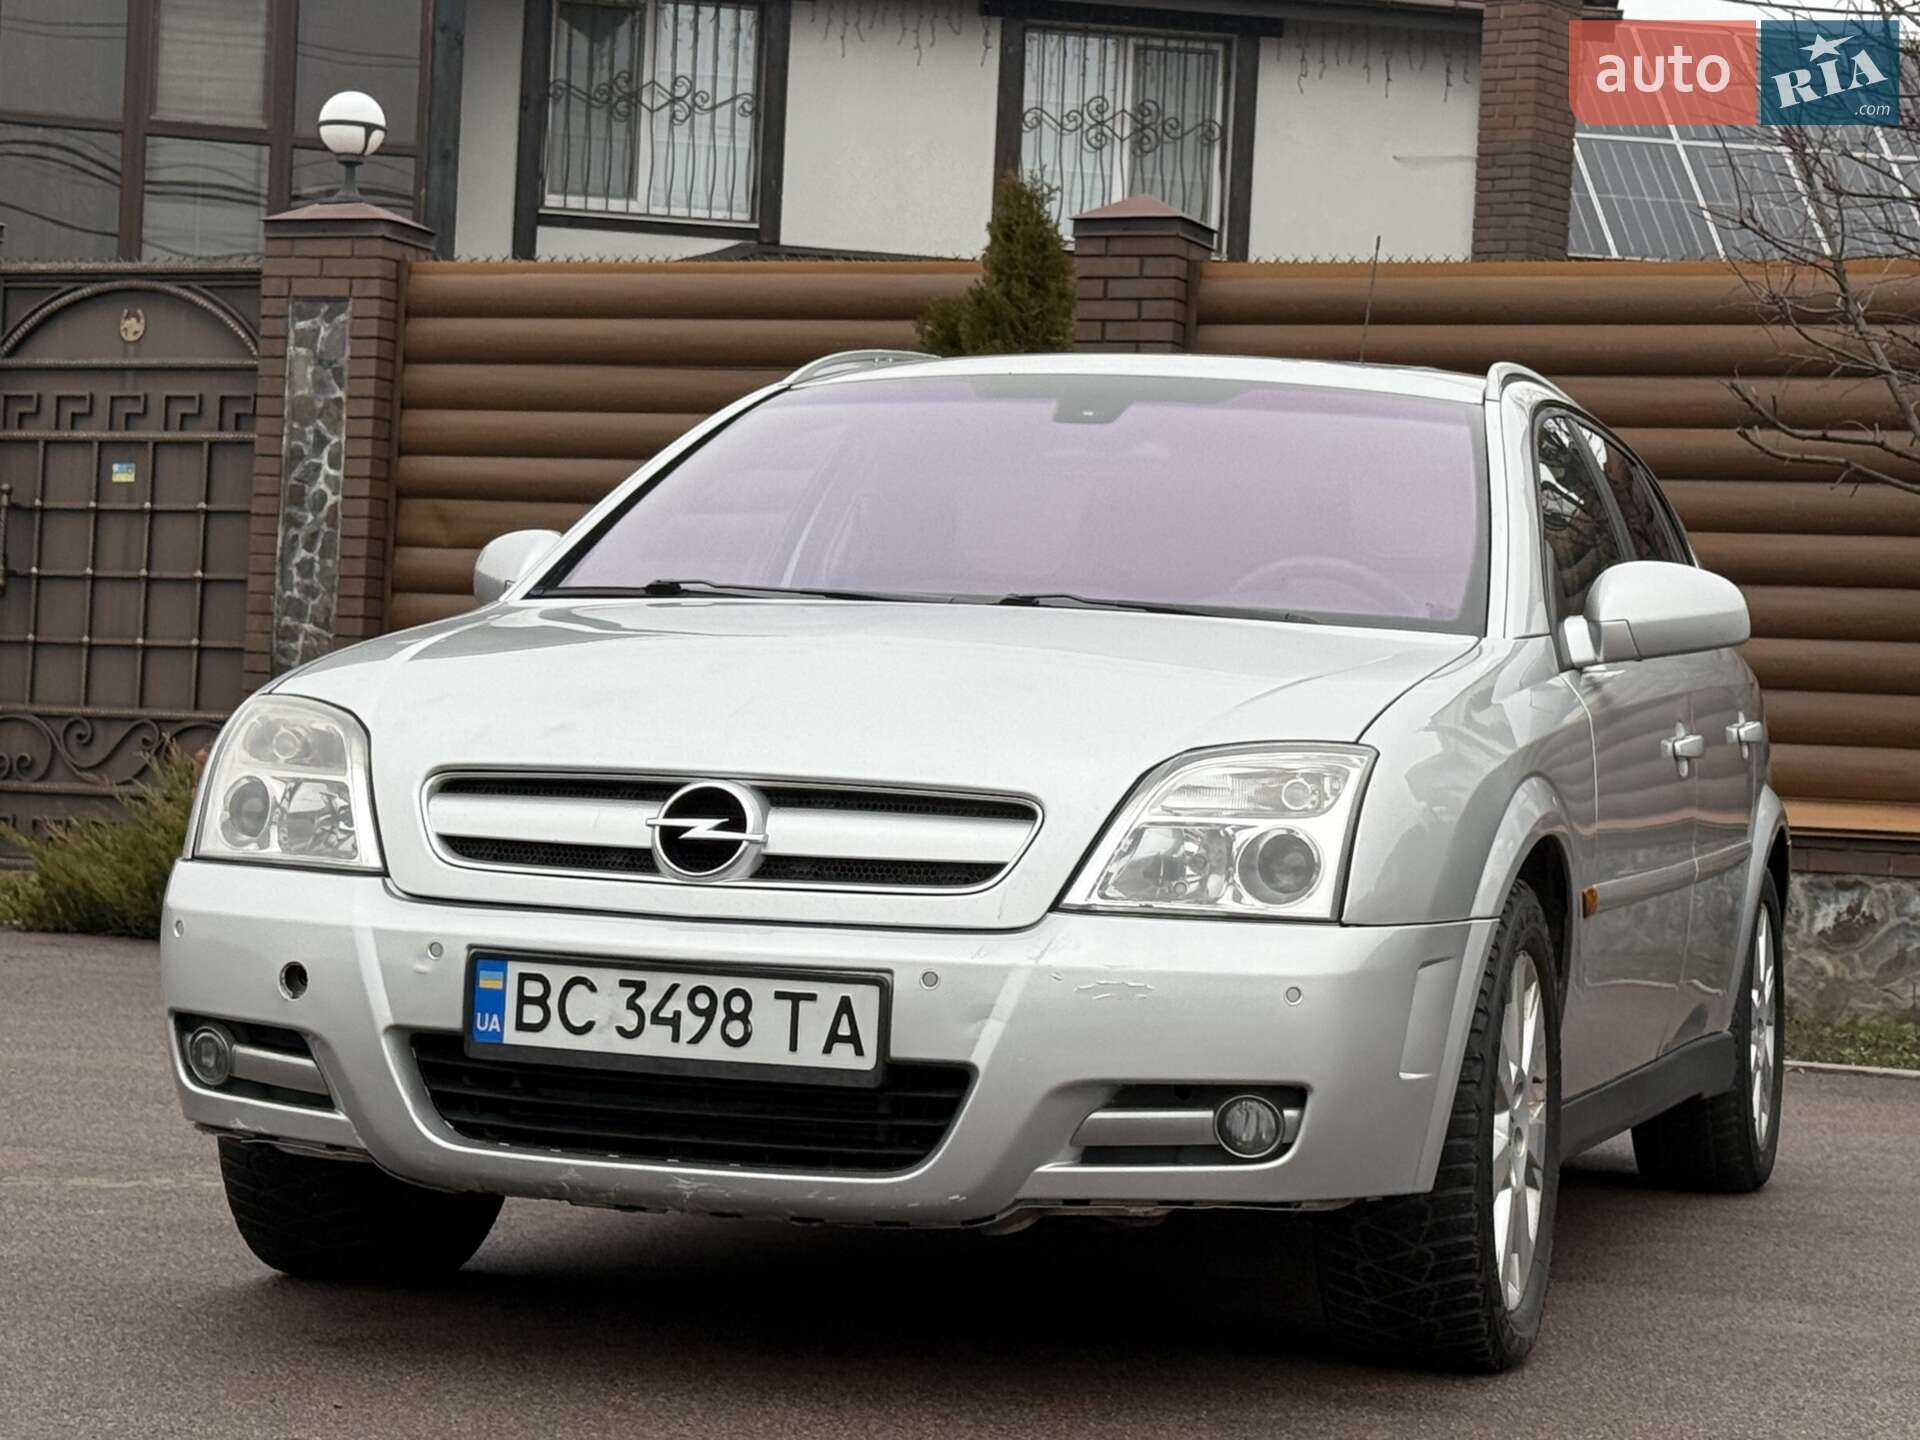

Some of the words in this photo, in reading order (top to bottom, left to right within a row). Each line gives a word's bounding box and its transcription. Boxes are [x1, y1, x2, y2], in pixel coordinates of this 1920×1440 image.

[476, 1012, 501, 1033] UA
[515, 972, 598, 1036] BC
[615, 979, 753, 1048] 3498
[774, 990, 865, 1057] TA
